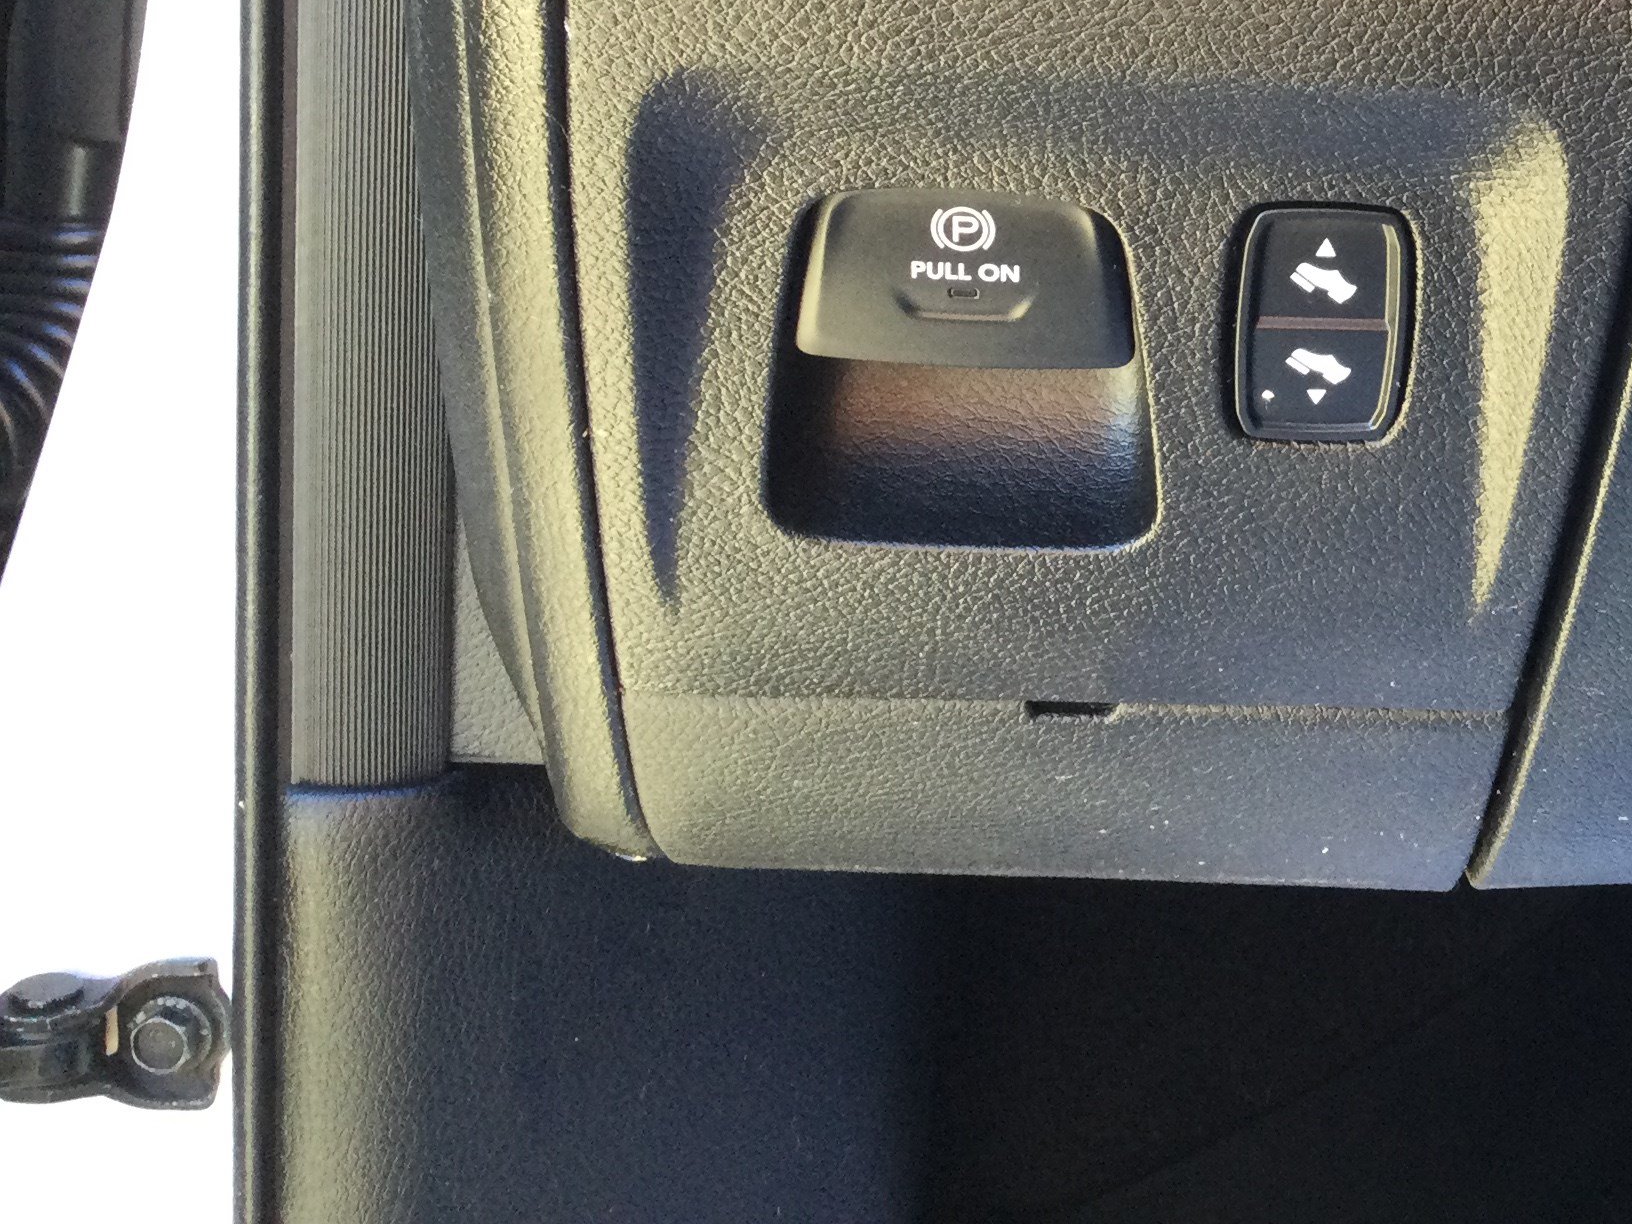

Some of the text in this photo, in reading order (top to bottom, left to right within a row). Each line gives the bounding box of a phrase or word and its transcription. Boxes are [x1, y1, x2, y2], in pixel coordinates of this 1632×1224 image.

[952, 215, 980, 243] P
[910, 260, 1020, 283] PULL ON
